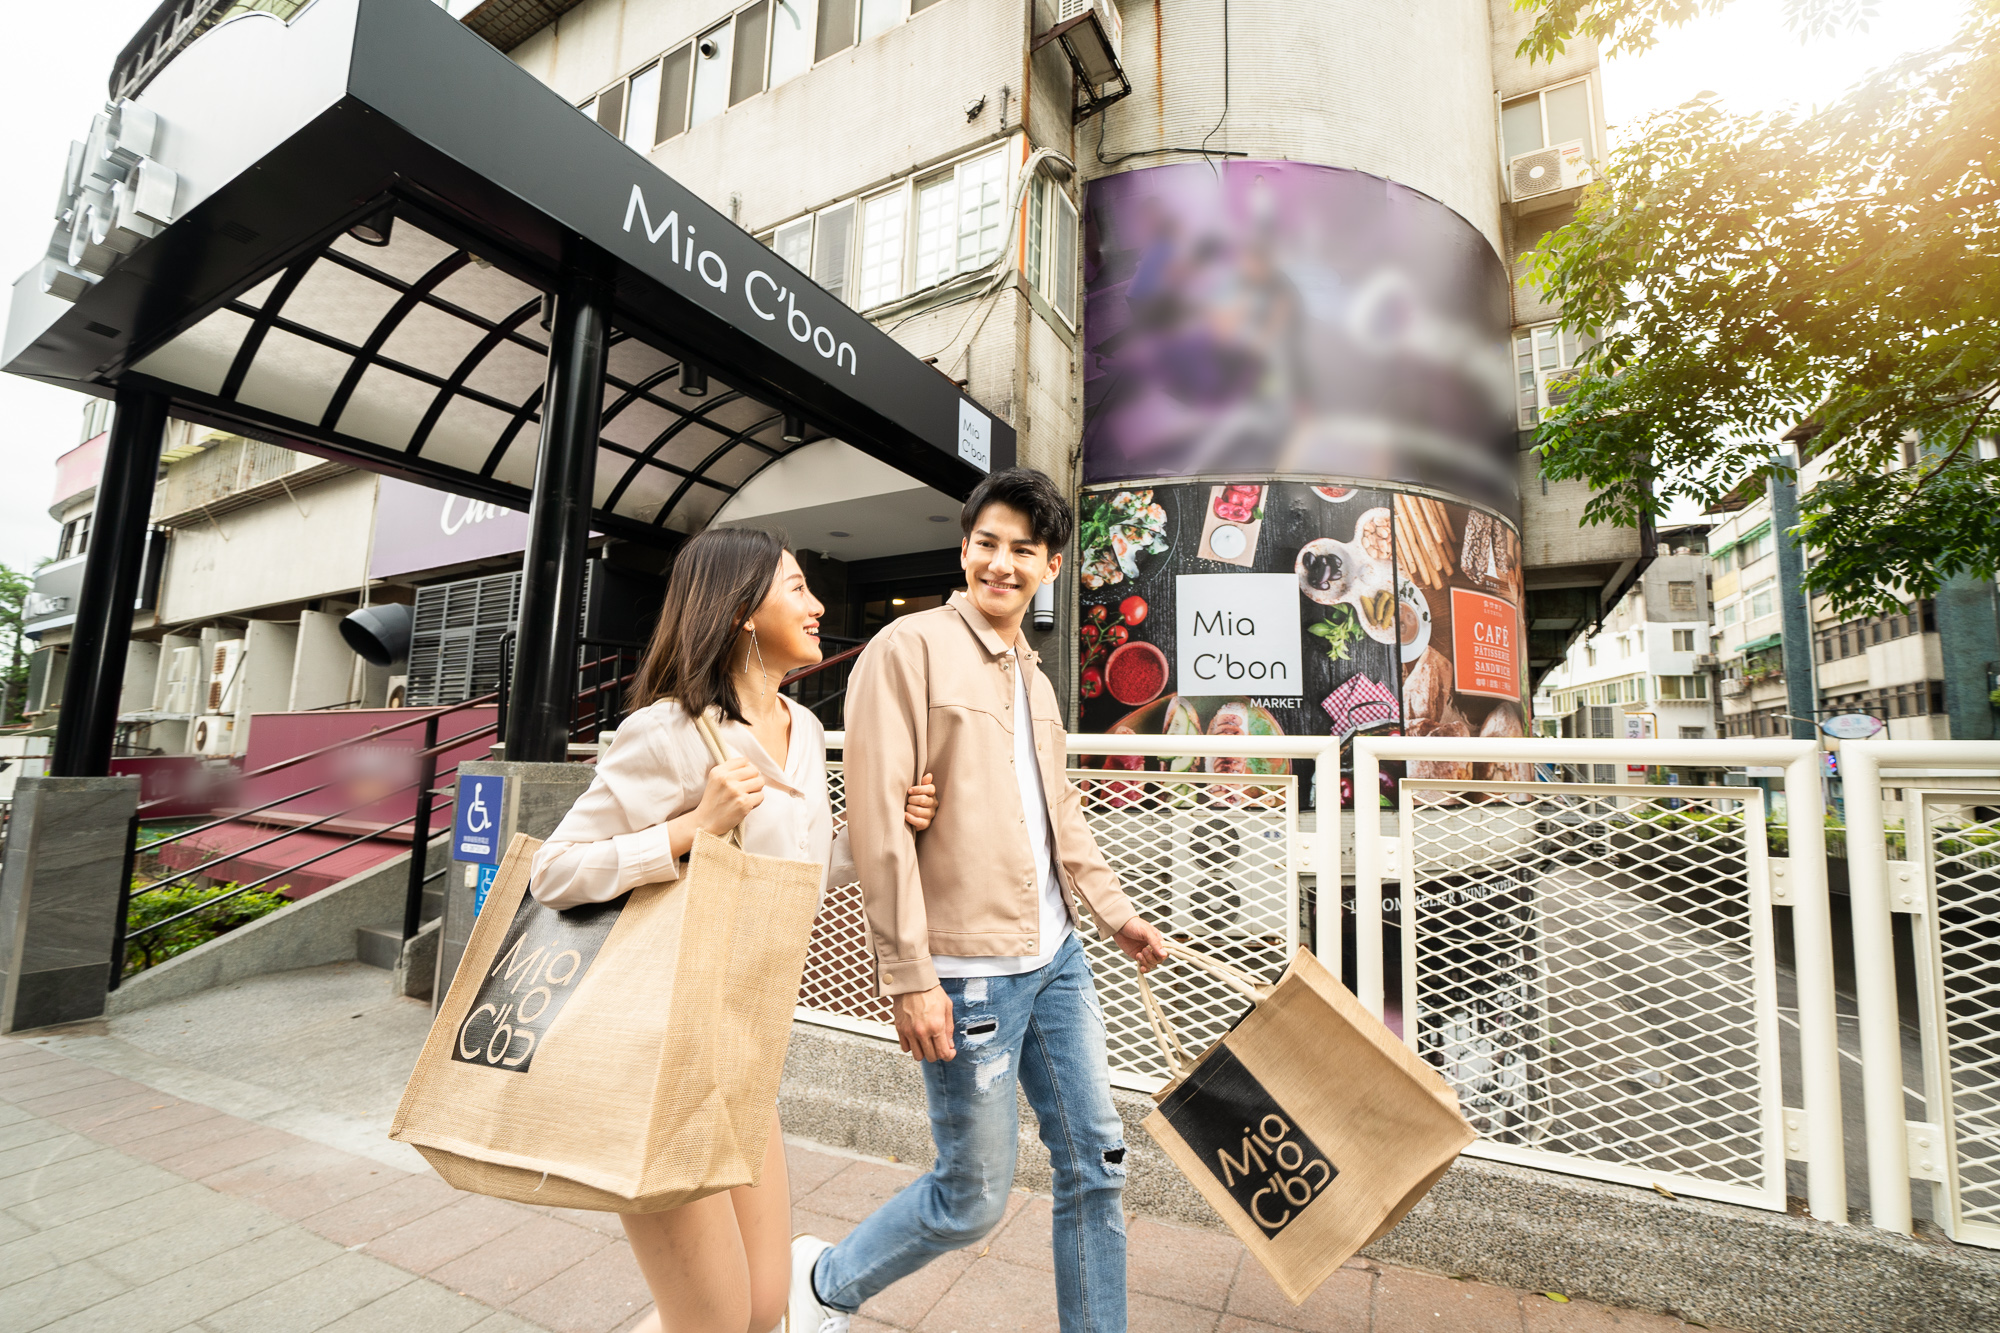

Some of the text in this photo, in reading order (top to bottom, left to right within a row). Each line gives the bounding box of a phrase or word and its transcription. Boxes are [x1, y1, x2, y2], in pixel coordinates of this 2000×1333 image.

[622, 183, 857, 376] Mia C'bon
[963, 418, 980, 439] Mia
[962, 438, 987, 465] C'bon
[1193, 610, 1255, 637] Mia
[1474, 621, 1510, 648] CAFÉ
[1193, 652, 1287, 680] C'bon
[1474, 645, 1510, 662] PÂTISSERIE
[1474, 660, 1511, 677] SANDWICH
[1250, 697, 1303, 709] MARKET
[1460, 885, 1488, 902] WINE
[491, 931, 581, 995] Mia
[1216, 1113, 1291, 1188] Mia
[1250, 1140, 1331, 1229] C'bon
